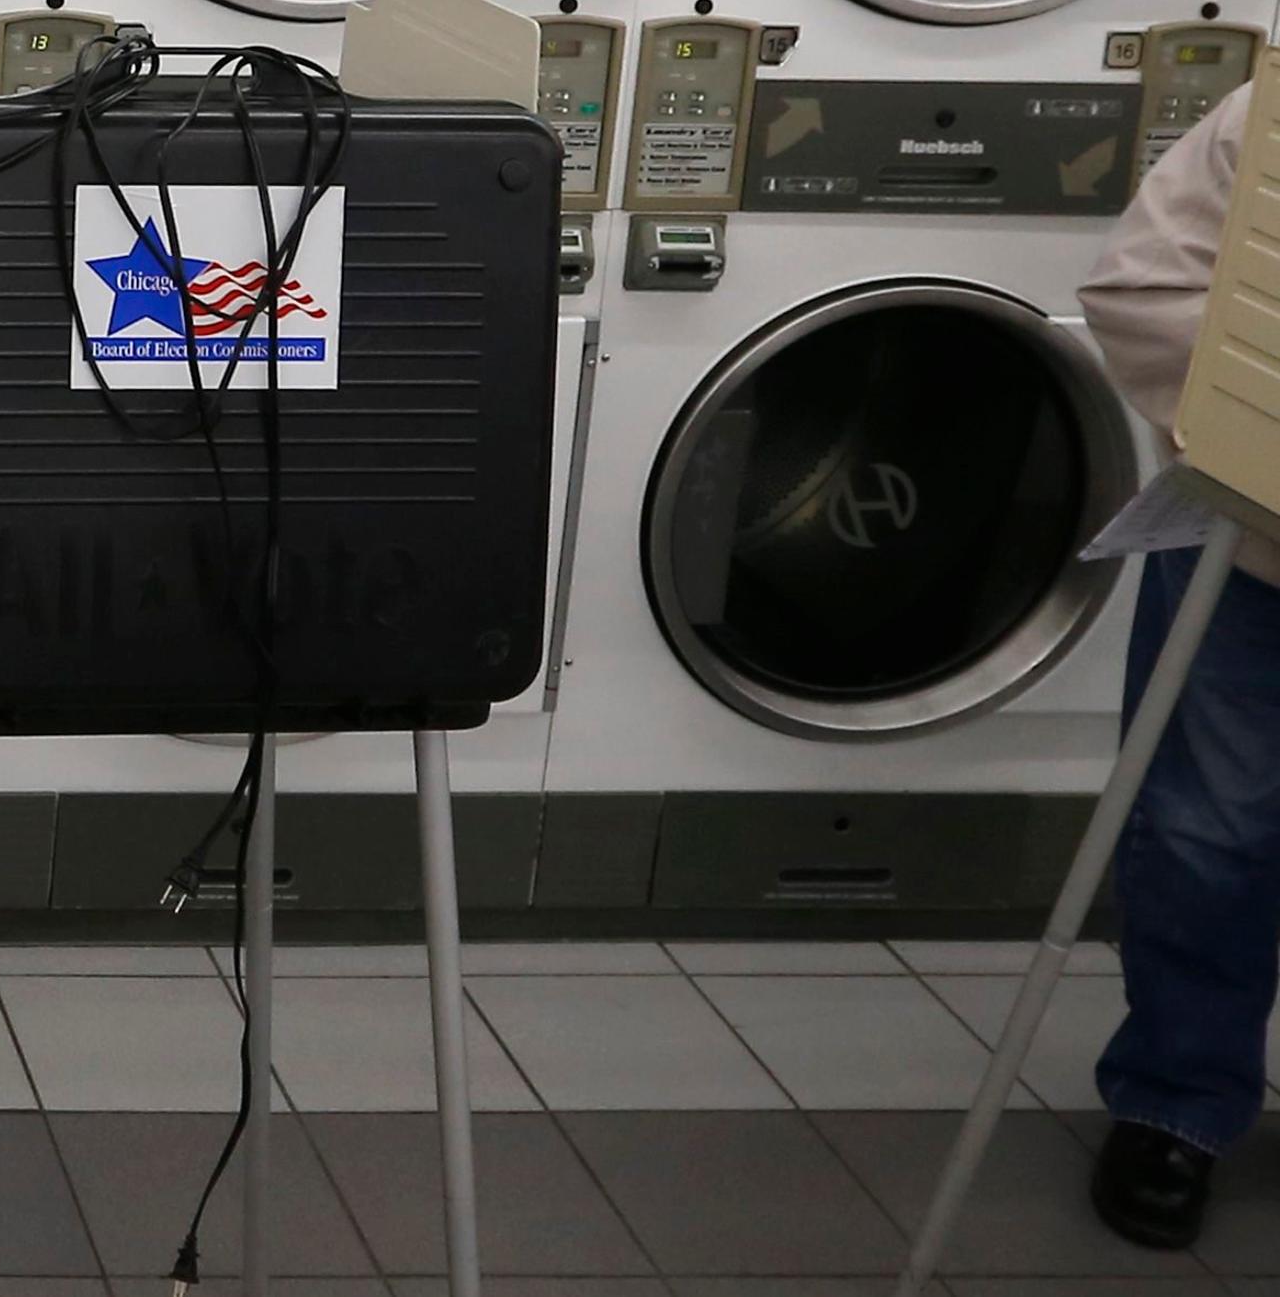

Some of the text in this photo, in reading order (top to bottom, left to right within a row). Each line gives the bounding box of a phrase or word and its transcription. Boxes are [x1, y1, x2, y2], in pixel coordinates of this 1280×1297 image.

[32, 36, 48, 50] 13
[677, 43, 692, 57] 15
[1117, 44, 1135, 59] 16
[900, 139, 984, 154] Huebsch
[92, 341, 134, 357] Board
[136, 341, 152, 357] of
